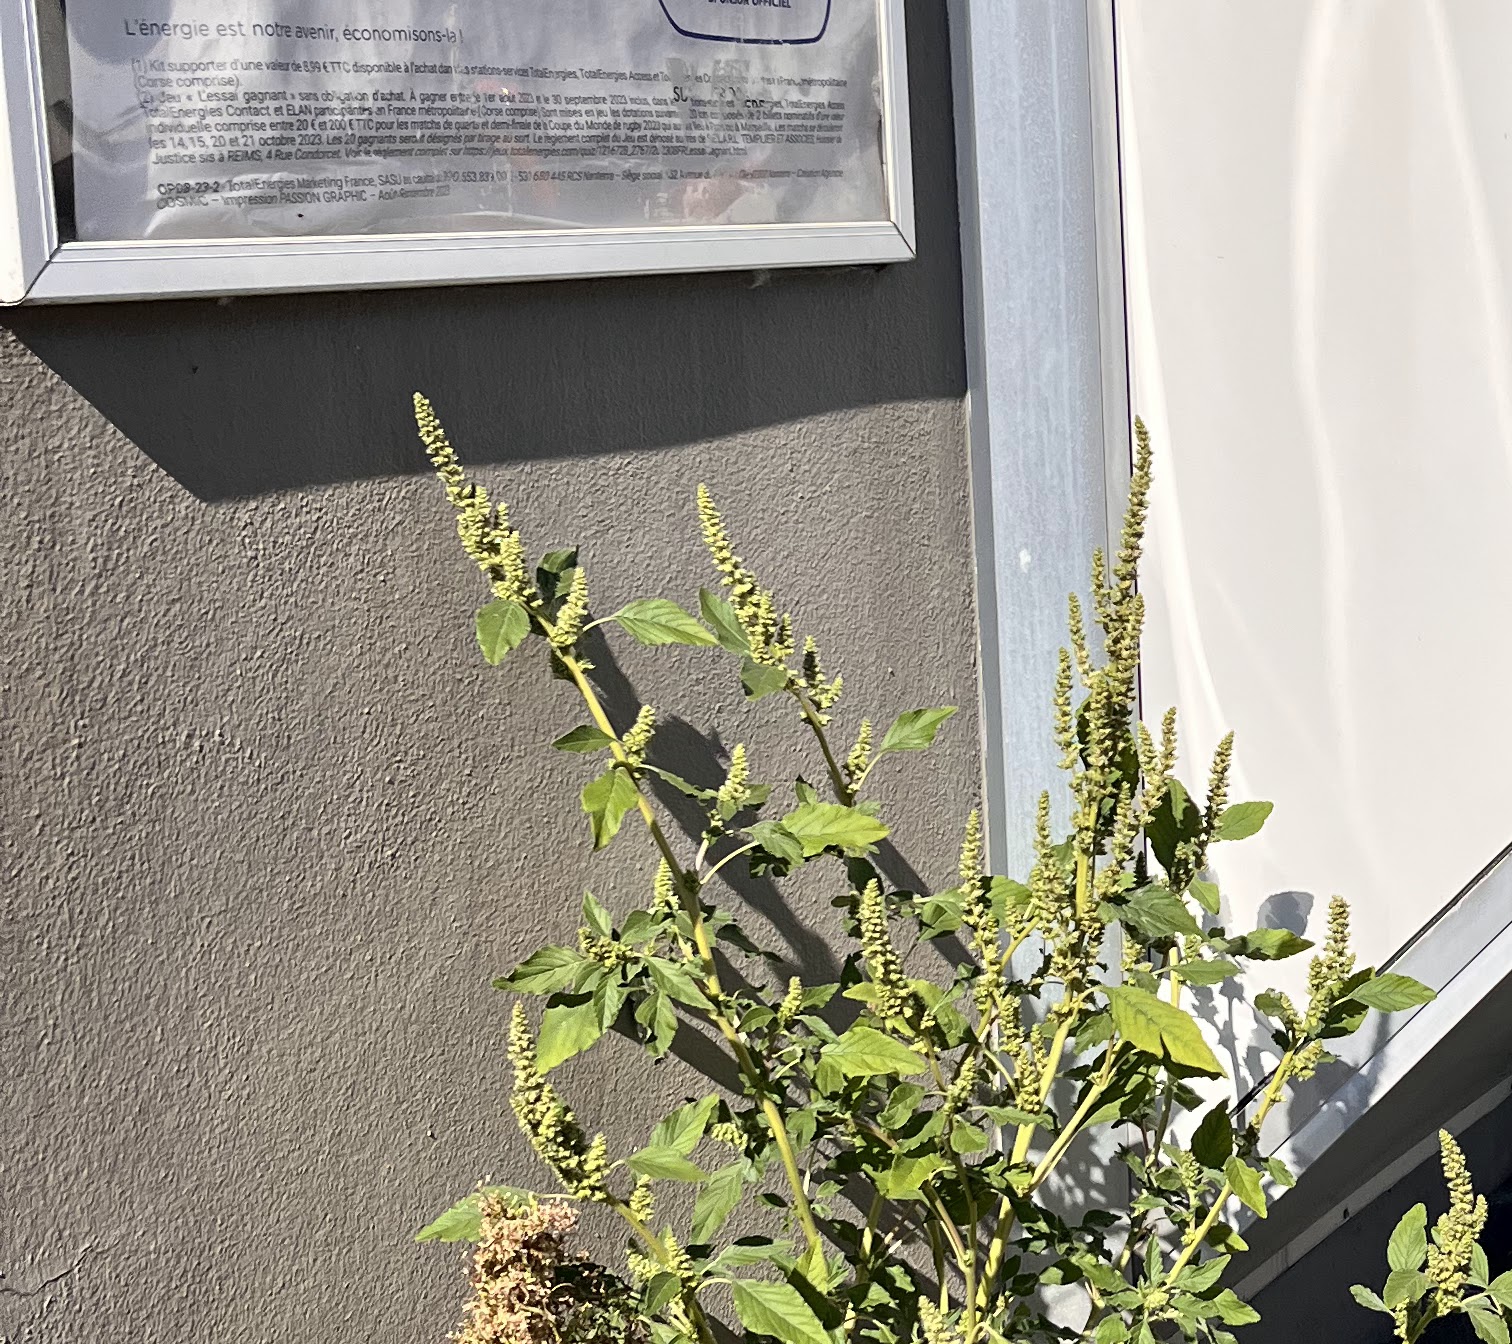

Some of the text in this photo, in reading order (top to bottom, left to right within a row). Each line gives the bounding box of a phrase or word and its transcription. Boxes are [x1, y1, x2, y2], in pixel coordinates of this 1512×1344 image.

[124, 17, 209, 40] L'énergie
[216, 20, 246, 37] est
[252, 21, 292, 38] notre
[295, 23, 339, 43] avenir,
[342, 23, 457, 44] économisons-la
[330, 61, 351, 74] TTC
[225, 104, 271, 117] Contact
